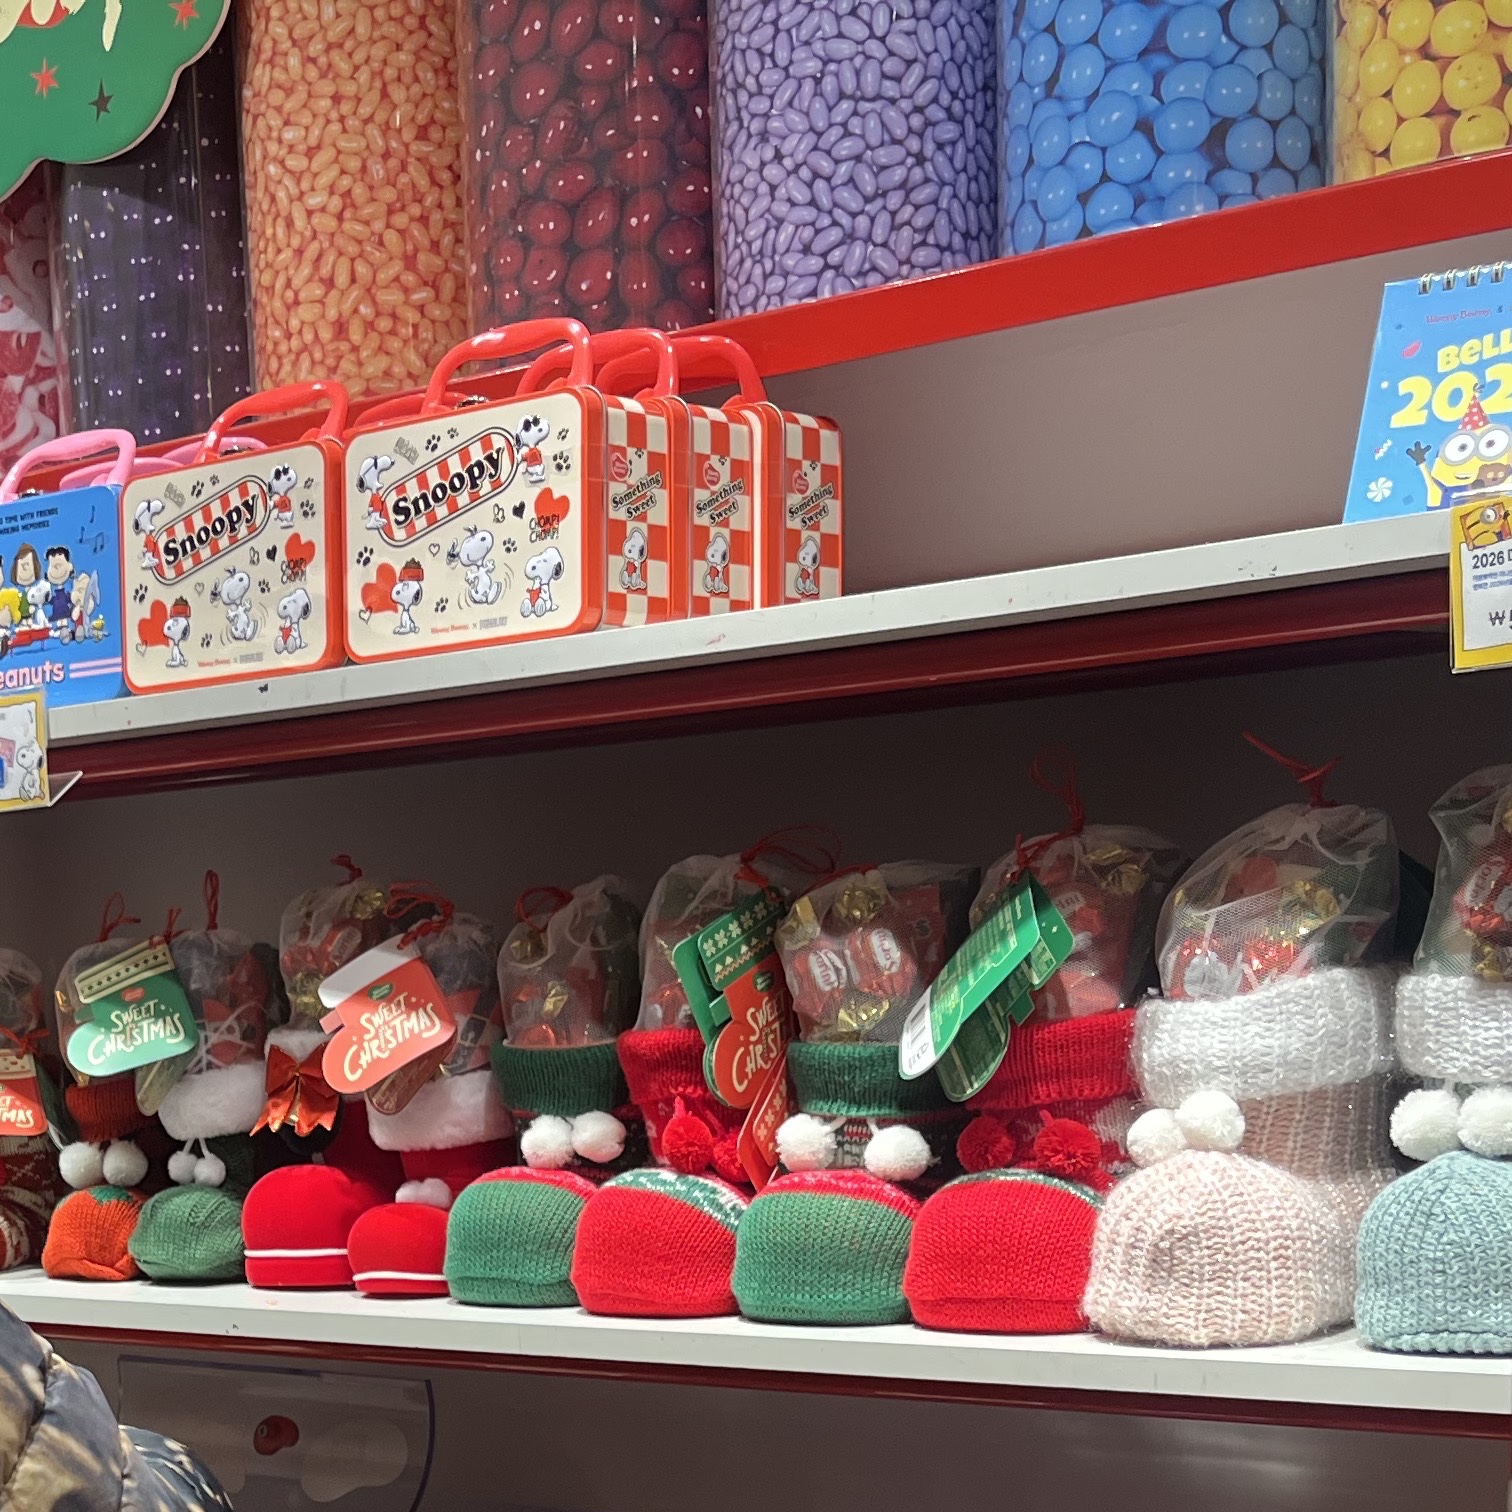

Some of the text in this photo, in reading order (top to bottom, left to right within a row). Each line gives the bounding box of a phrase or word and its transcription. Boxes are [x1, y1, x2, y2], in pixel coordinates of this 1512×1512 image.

[392, 446, 505, 527] Snoopy
[611, 471, 662, 509] Something
[695, 478, 744, 516] Something
[788, 483, 834, 519] Something
[529, 514, 561, 531] CHOMP!
[626, 493, 656, 520] Sweet
[709, 499, 738, 526] Sweet
[800, 503, 829, 529] Sweet
[163, 493, 258, 566] Snoopy
[529, 527, 561, 544] CHOMP!
[1471, 550, 1505, 570] 2026
[110, 998, 159, 1033] SWEET
[359, 992, 409, 1041] SWEET
[87, 1012, 186, 1066] CHRISTMAS
[343, 1002, 441, 1082] CHRISTMAS
[732, 1020, 786, 1093] CHRIST
